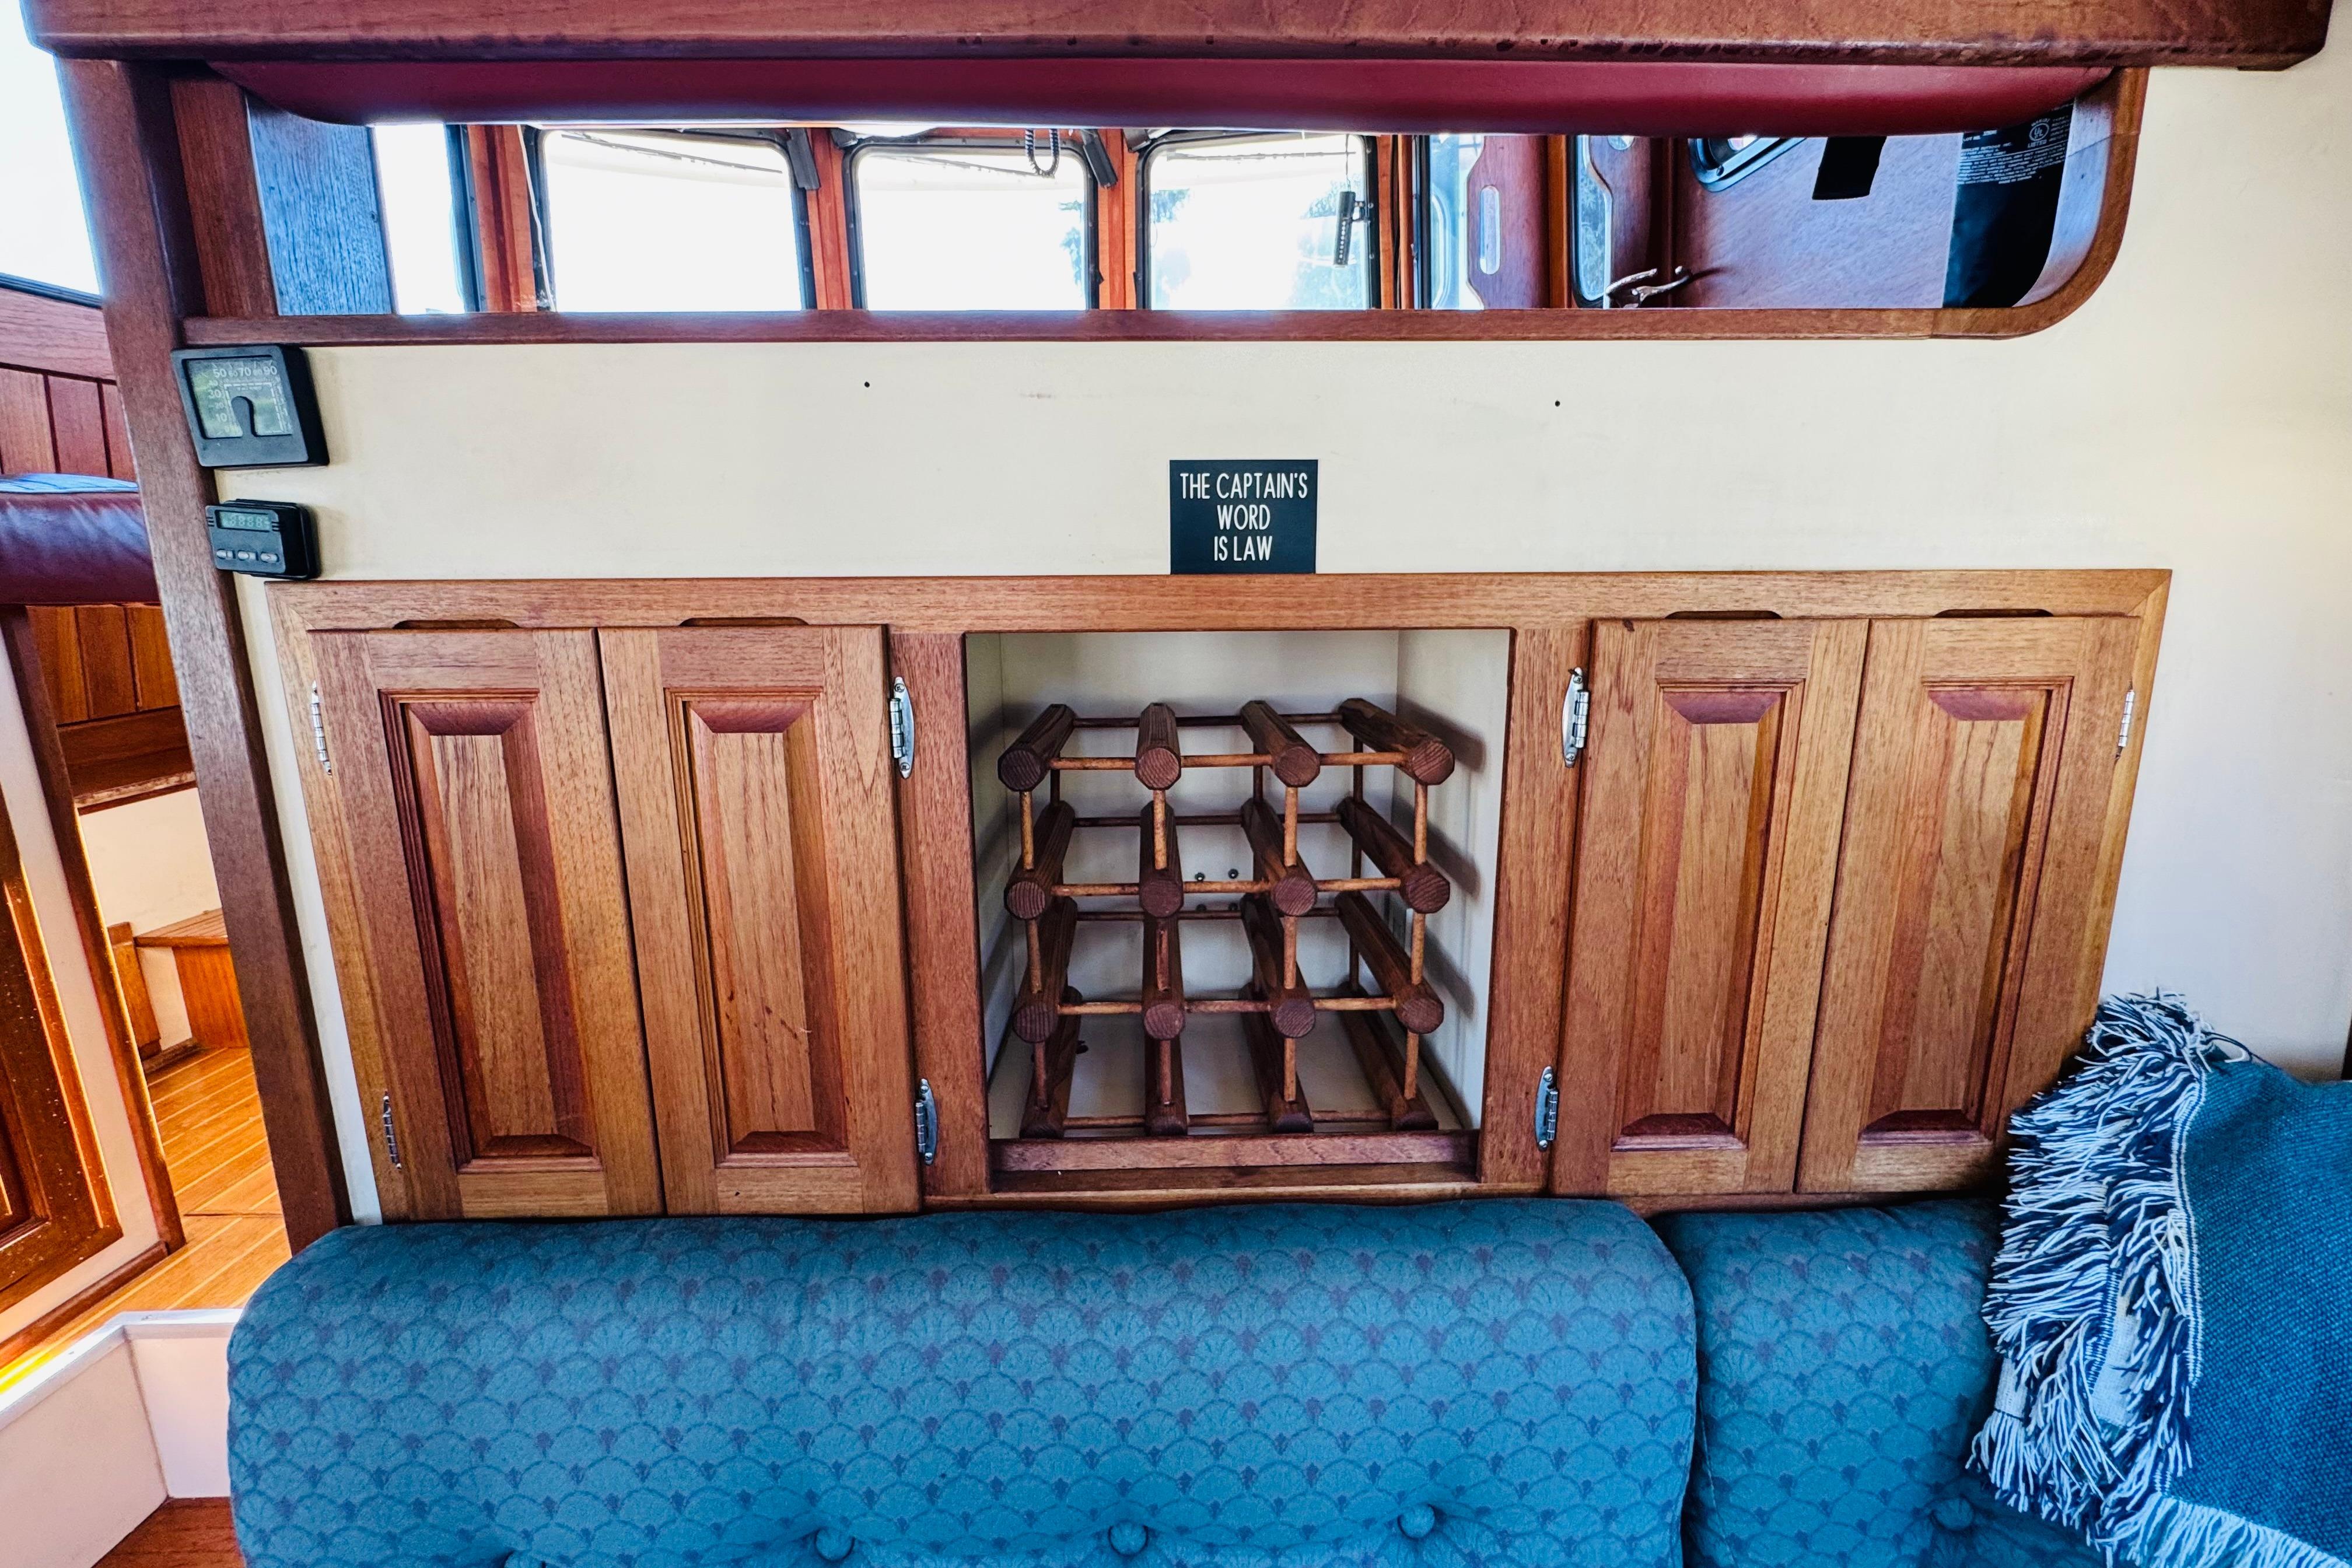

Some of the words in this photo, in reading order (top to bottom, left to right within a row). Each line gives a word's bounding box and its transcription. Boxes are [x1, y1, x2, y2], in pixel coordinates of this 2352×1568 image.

[213, 368, 227, 378] 50
[236, 367, 251, 376] 70
[263, 366, 278, 375] 90
[208, 389, 221, 399] 30
[215, 412, 228, 422] 10
[1180, 473, 1210, 499] THE
[1216, 473, 1308, 499] CAPTAIN'S
[1217, 504, 1271, 530] WORD
[1213, 536, 1228, 561] IS
[1233, 536, 1273, 561] LAW
